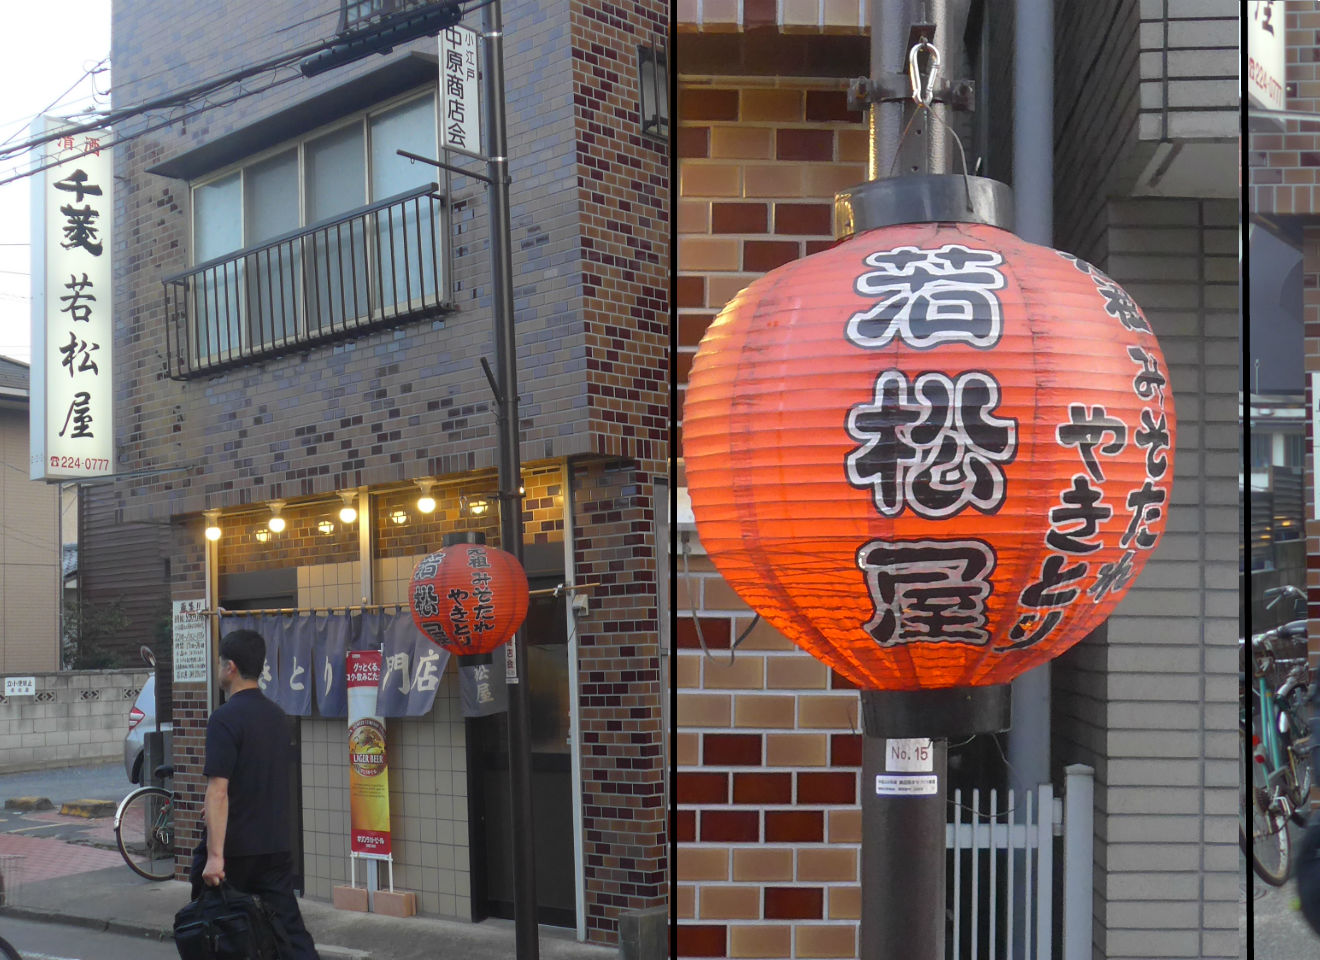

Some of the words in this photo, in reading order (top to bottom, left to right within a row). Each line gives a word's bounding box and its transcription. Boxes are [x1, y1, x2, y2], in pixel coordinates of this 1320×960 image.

[465, 32, 476, 82] 小江戸
[445, 26, 466, 148] 中原商店会
[58, 272, 100, 438] 若松屋
[61, 456, 110, 471] 224-0777
[844, 244, 1018, 648] 若松屋
[994, 402, 1128, 653] やきとり
[448, 588, 472, 647] やきとり
[473, 663, 495, 704] 松屋
[891, 746, 911, 760] No.
[915, 746, 928, 761] 15
